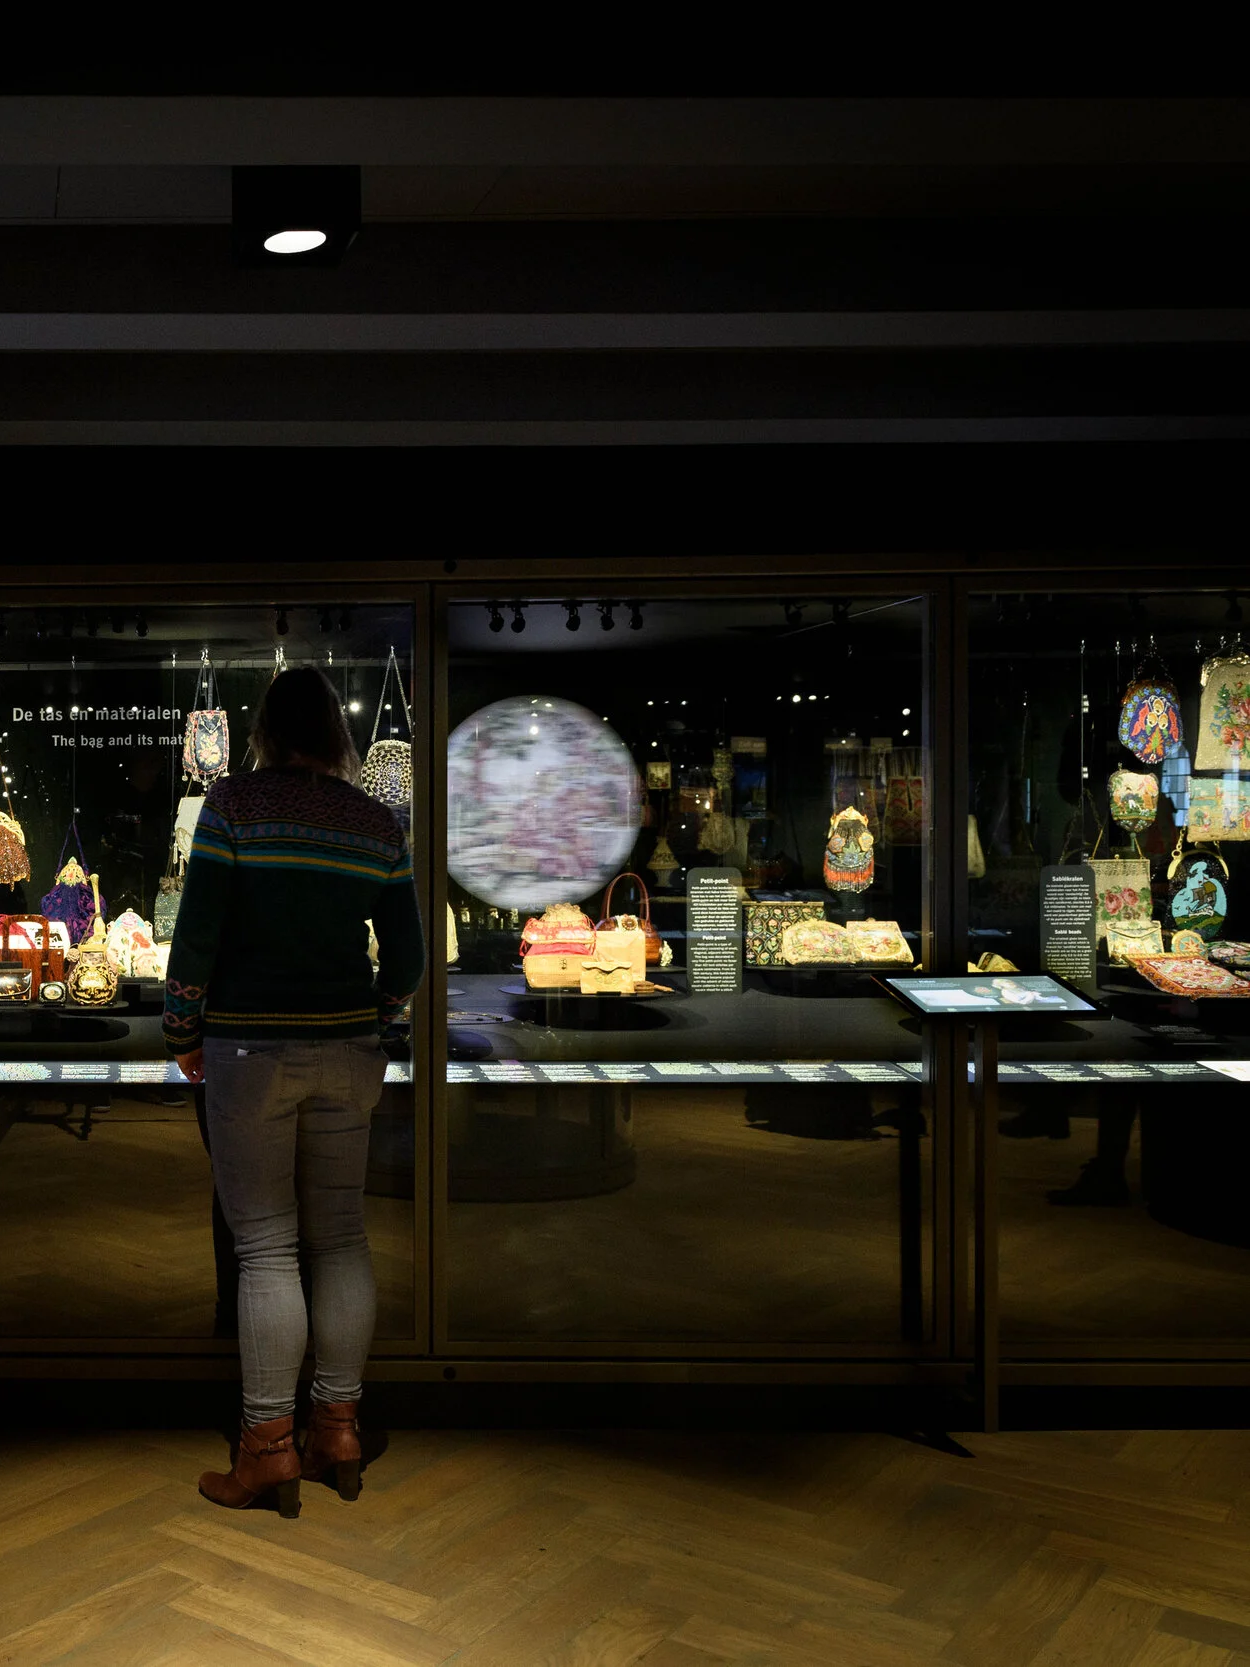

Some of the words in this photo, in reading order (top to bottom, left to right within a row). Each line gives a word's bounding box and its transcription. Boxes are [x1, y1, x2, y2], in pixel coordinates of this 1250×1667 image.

[13, 708, 33, 721] De
[40, 708, 63, 721] tas
[70, 710, 88, 720] en
[96, 706, 181, 720] materialen
[52, 734, 75, 747] The
[81, 734, 104, 748] bag
[108, 734, 132, 746] and
[137, 734, 153, 746] its
